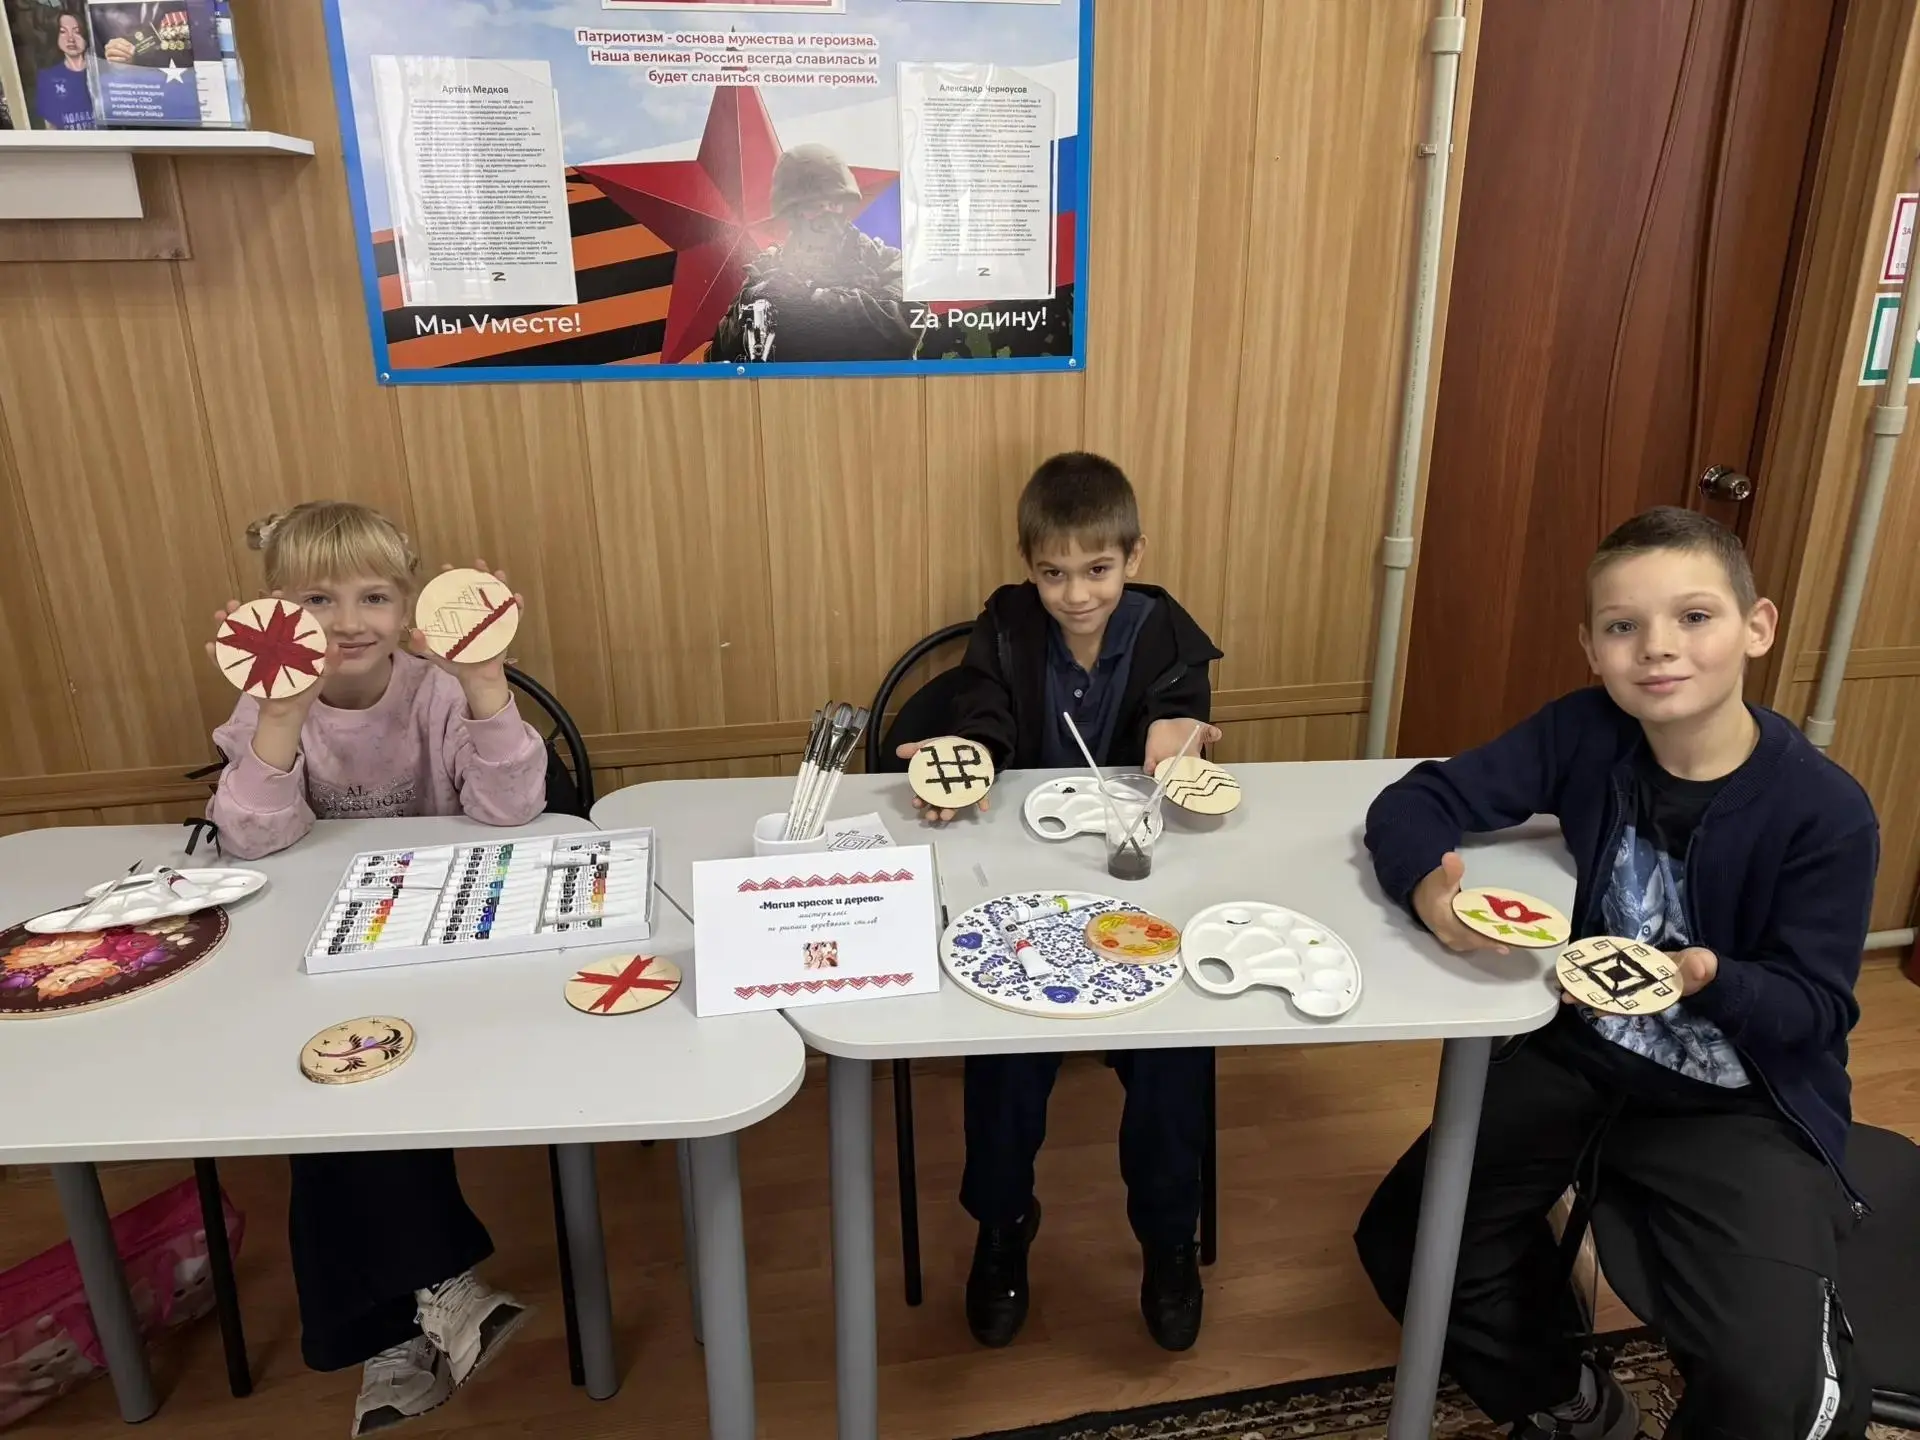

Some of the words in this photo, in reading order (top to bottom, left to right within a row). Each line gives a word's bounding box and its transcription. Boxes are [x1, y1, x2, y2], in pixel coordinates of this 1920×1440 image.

[577, 30, 664, 43] Патриотизм
[676, 34, 725, 44] основа
[728, 35, 794, 48] мужества
[797, 36, 806, 45] и
[809, 36, 877, 48] героизма.
[591, 50, 631, 62] Наша
[633, 53, 691, 63] великая
[695, 52, 744, 64] Россия
[747, 54, 792, 66] всегда
[796, 54, 865, 65] славилась
[868, 55, 877, 65] и
[648, 70, 687, 85] будет
[691, 73, 760, 84] славиться
[764, 73, 815, 84] своими
[818, 73, 878, 87] героями.
[441, 84, 471, 95] Артём
[473, 85, 509, 95] Медков
[939, 83, 983, 94] Александр
[986, 84, 1028, 95] Черноусов
[414, 315, 462, 335] Мы
[948, 306, 1047, 331] Родину!
[797, 899, 833, 909] красок
